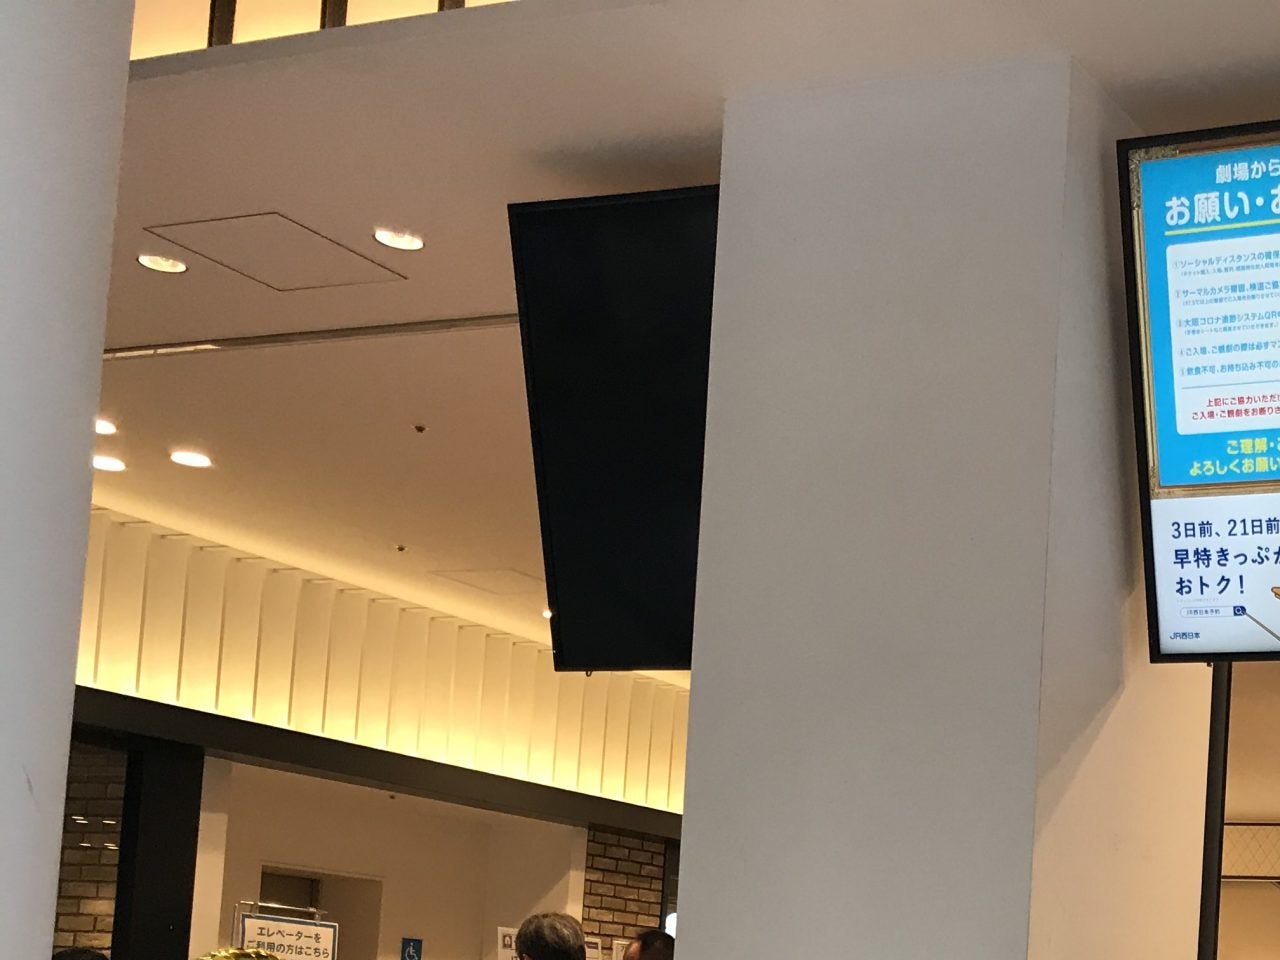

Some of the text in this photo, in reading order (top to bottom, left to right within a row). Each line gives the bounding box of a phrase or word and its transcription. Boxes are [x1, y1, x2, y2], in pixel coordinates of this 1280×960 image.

[257, 926, 322, 943] エレベーターを
